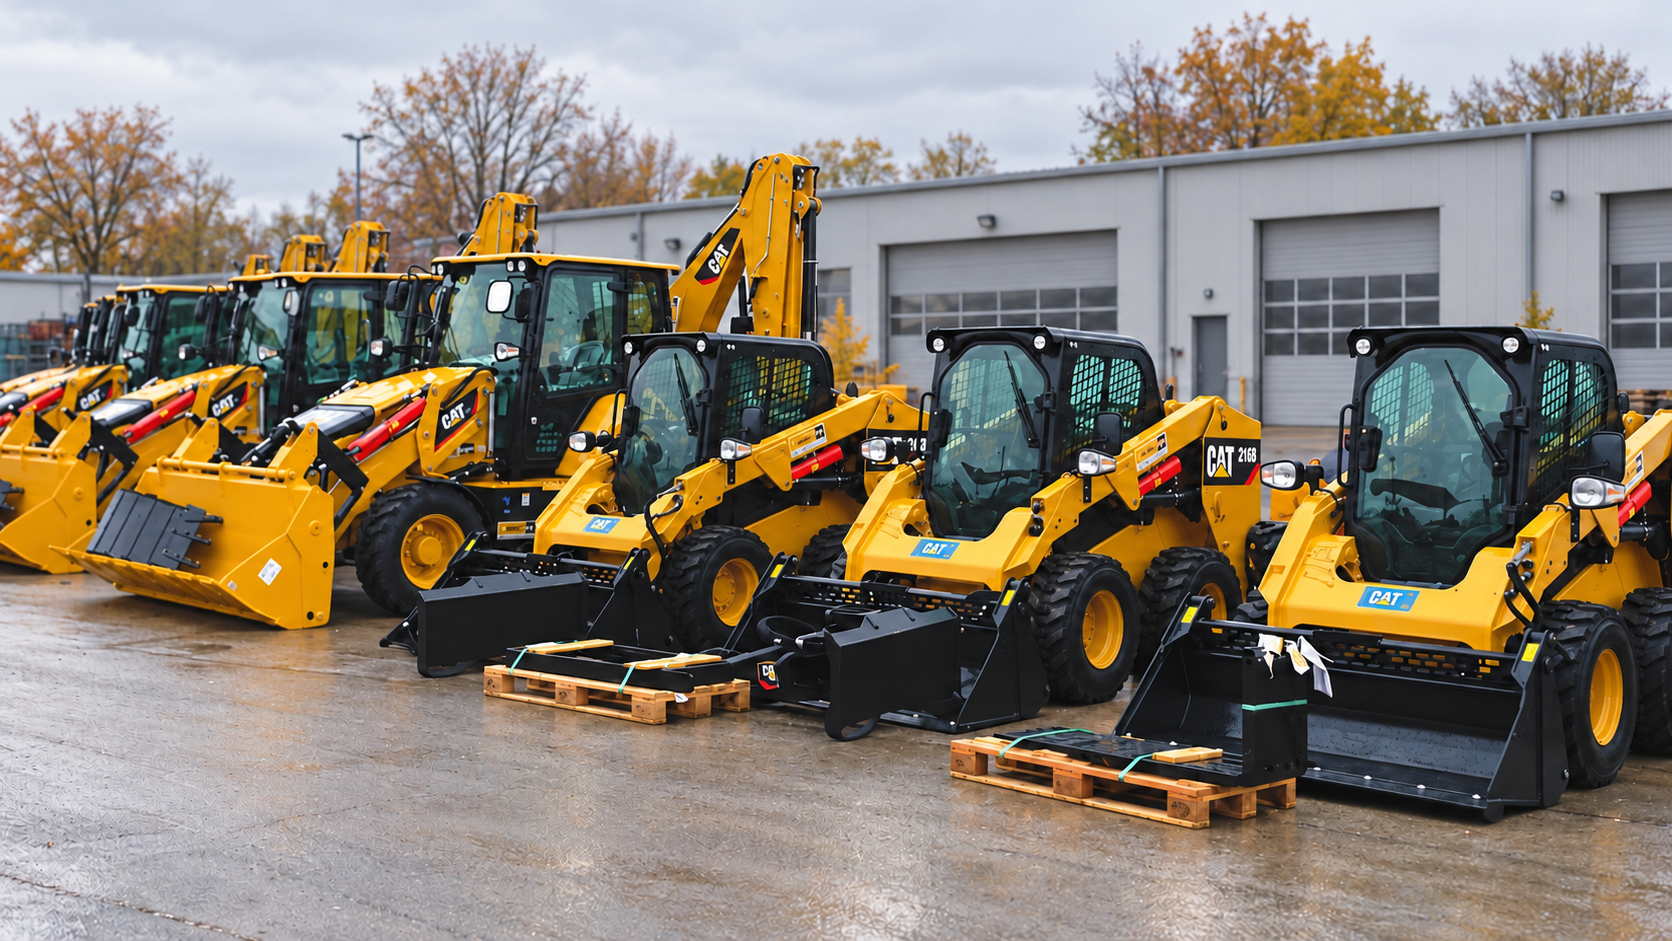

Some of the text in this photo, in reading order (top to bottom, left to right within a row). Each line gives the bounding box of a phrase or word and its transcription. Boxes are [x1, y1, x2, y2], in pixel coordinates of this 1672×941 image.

[708, 244, 729, 274] CAT
[80, 388, 100, 409] CAT
[212, 394, 234, 416] CAT
[441, 403, 465, 429] CAT
[1206, 444, 1234, 477] CAT
[591, 519, 611, 529] CAT
[922, 542, 947, 555] CAT
[1369, 591, 1403, 606] CAT
